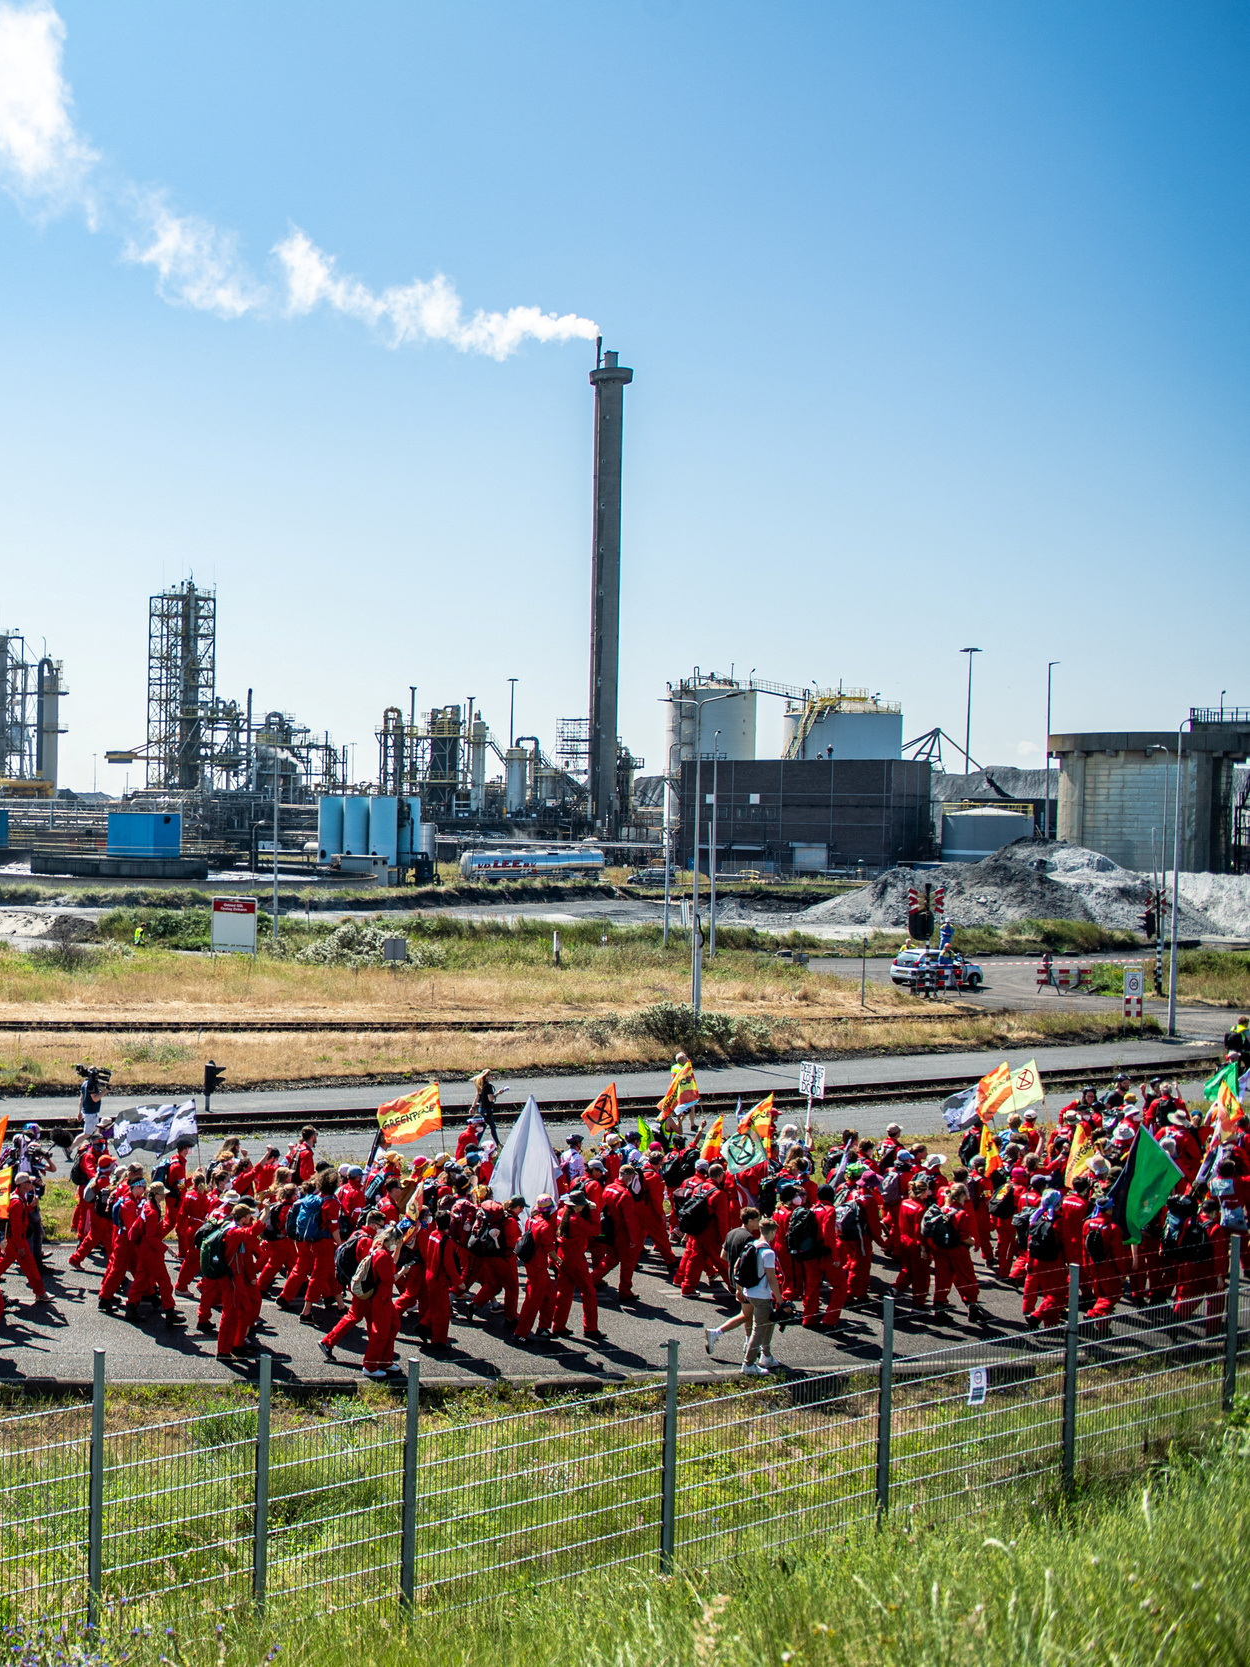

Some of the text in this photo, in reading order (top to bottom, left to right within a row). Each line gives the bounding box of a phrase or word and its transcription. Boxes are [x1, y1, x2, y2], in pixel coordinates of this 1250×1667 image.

[493, 859, 523, 868] LEE
[801, 1081, 821, 1097] DOOD
[381, 1102, 437, 1130] GREENPEACE
